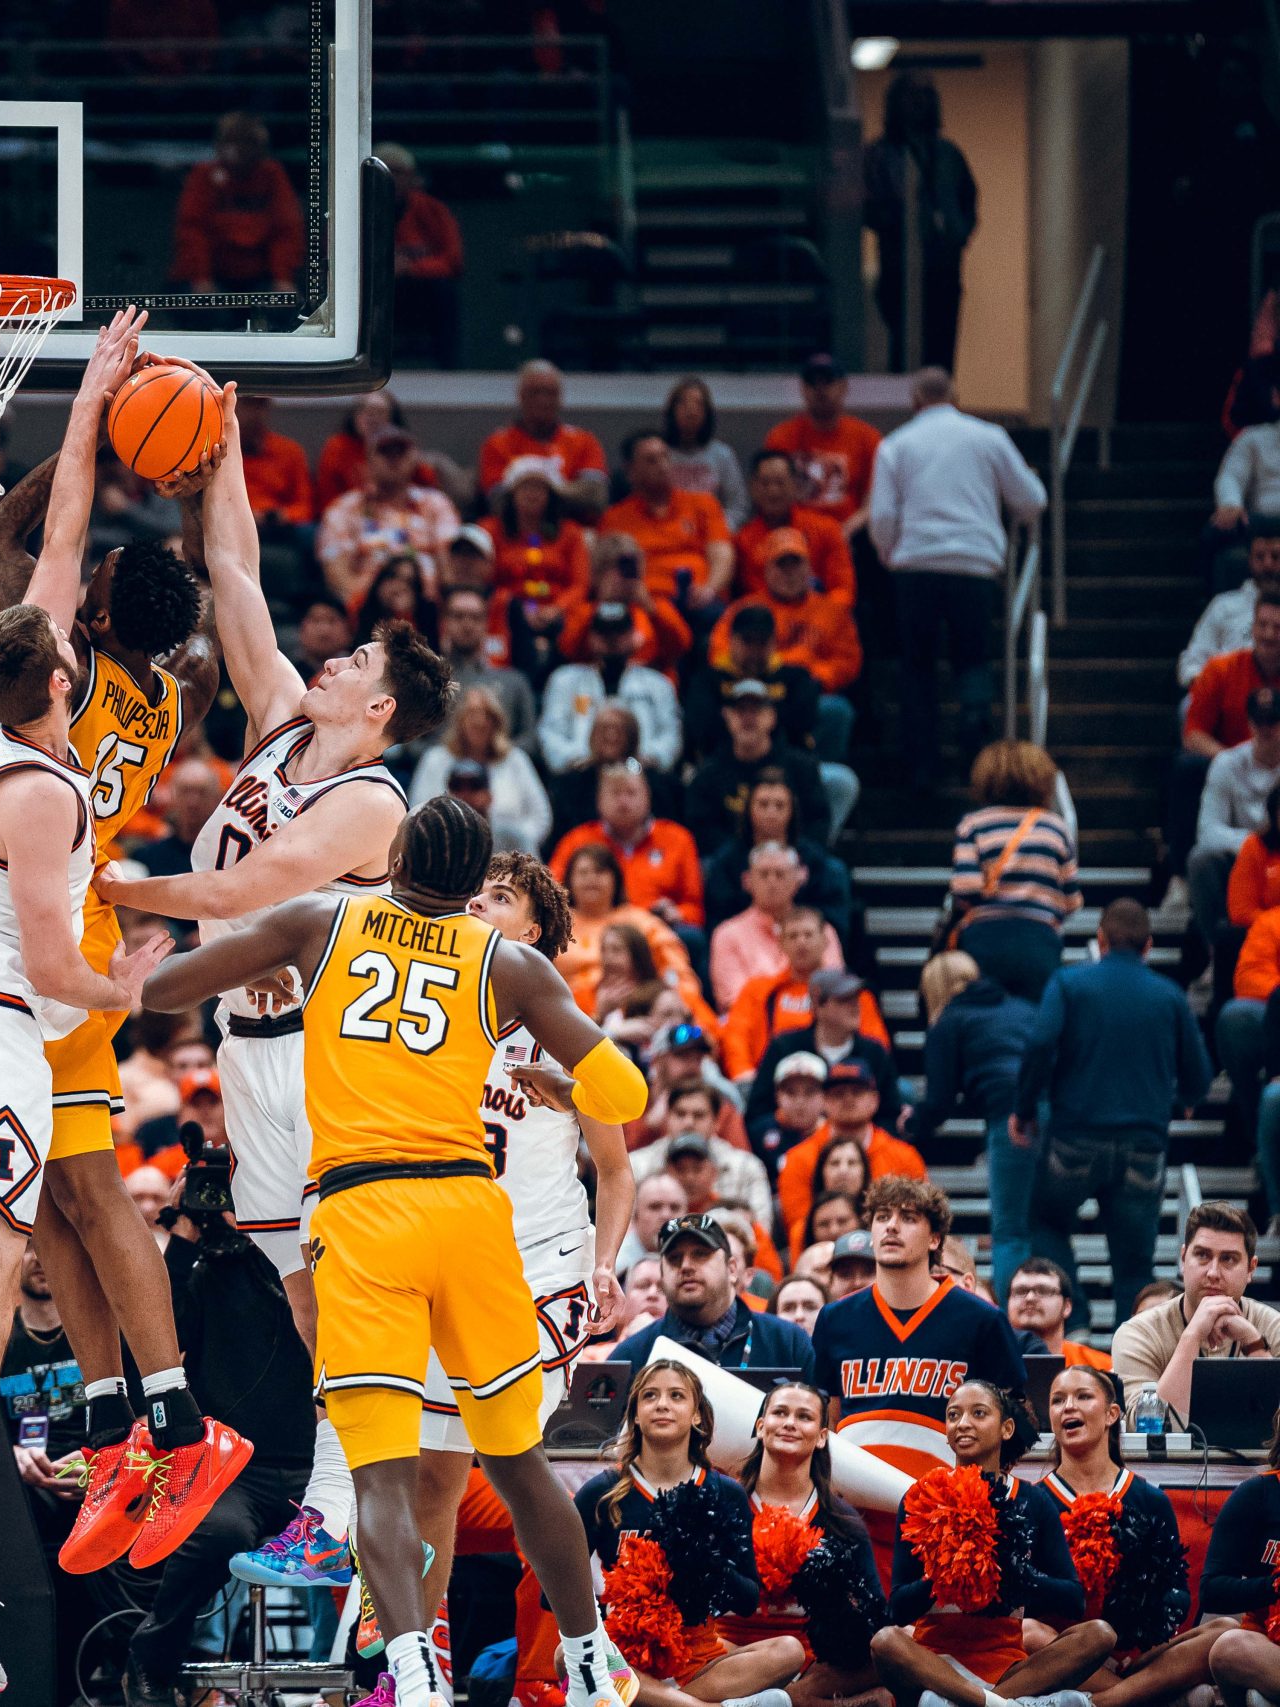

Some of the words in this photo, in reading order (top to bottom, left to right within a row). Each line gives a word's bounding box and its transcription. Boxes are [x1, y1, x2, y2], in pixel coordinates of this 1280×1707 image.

[88, 731, 149, 820] 15
[361, 910, 461, 958] MITCHELL
[339, 950, 461, 1057] 25
[841, 1358, 968, 1399] ILLINOIS
